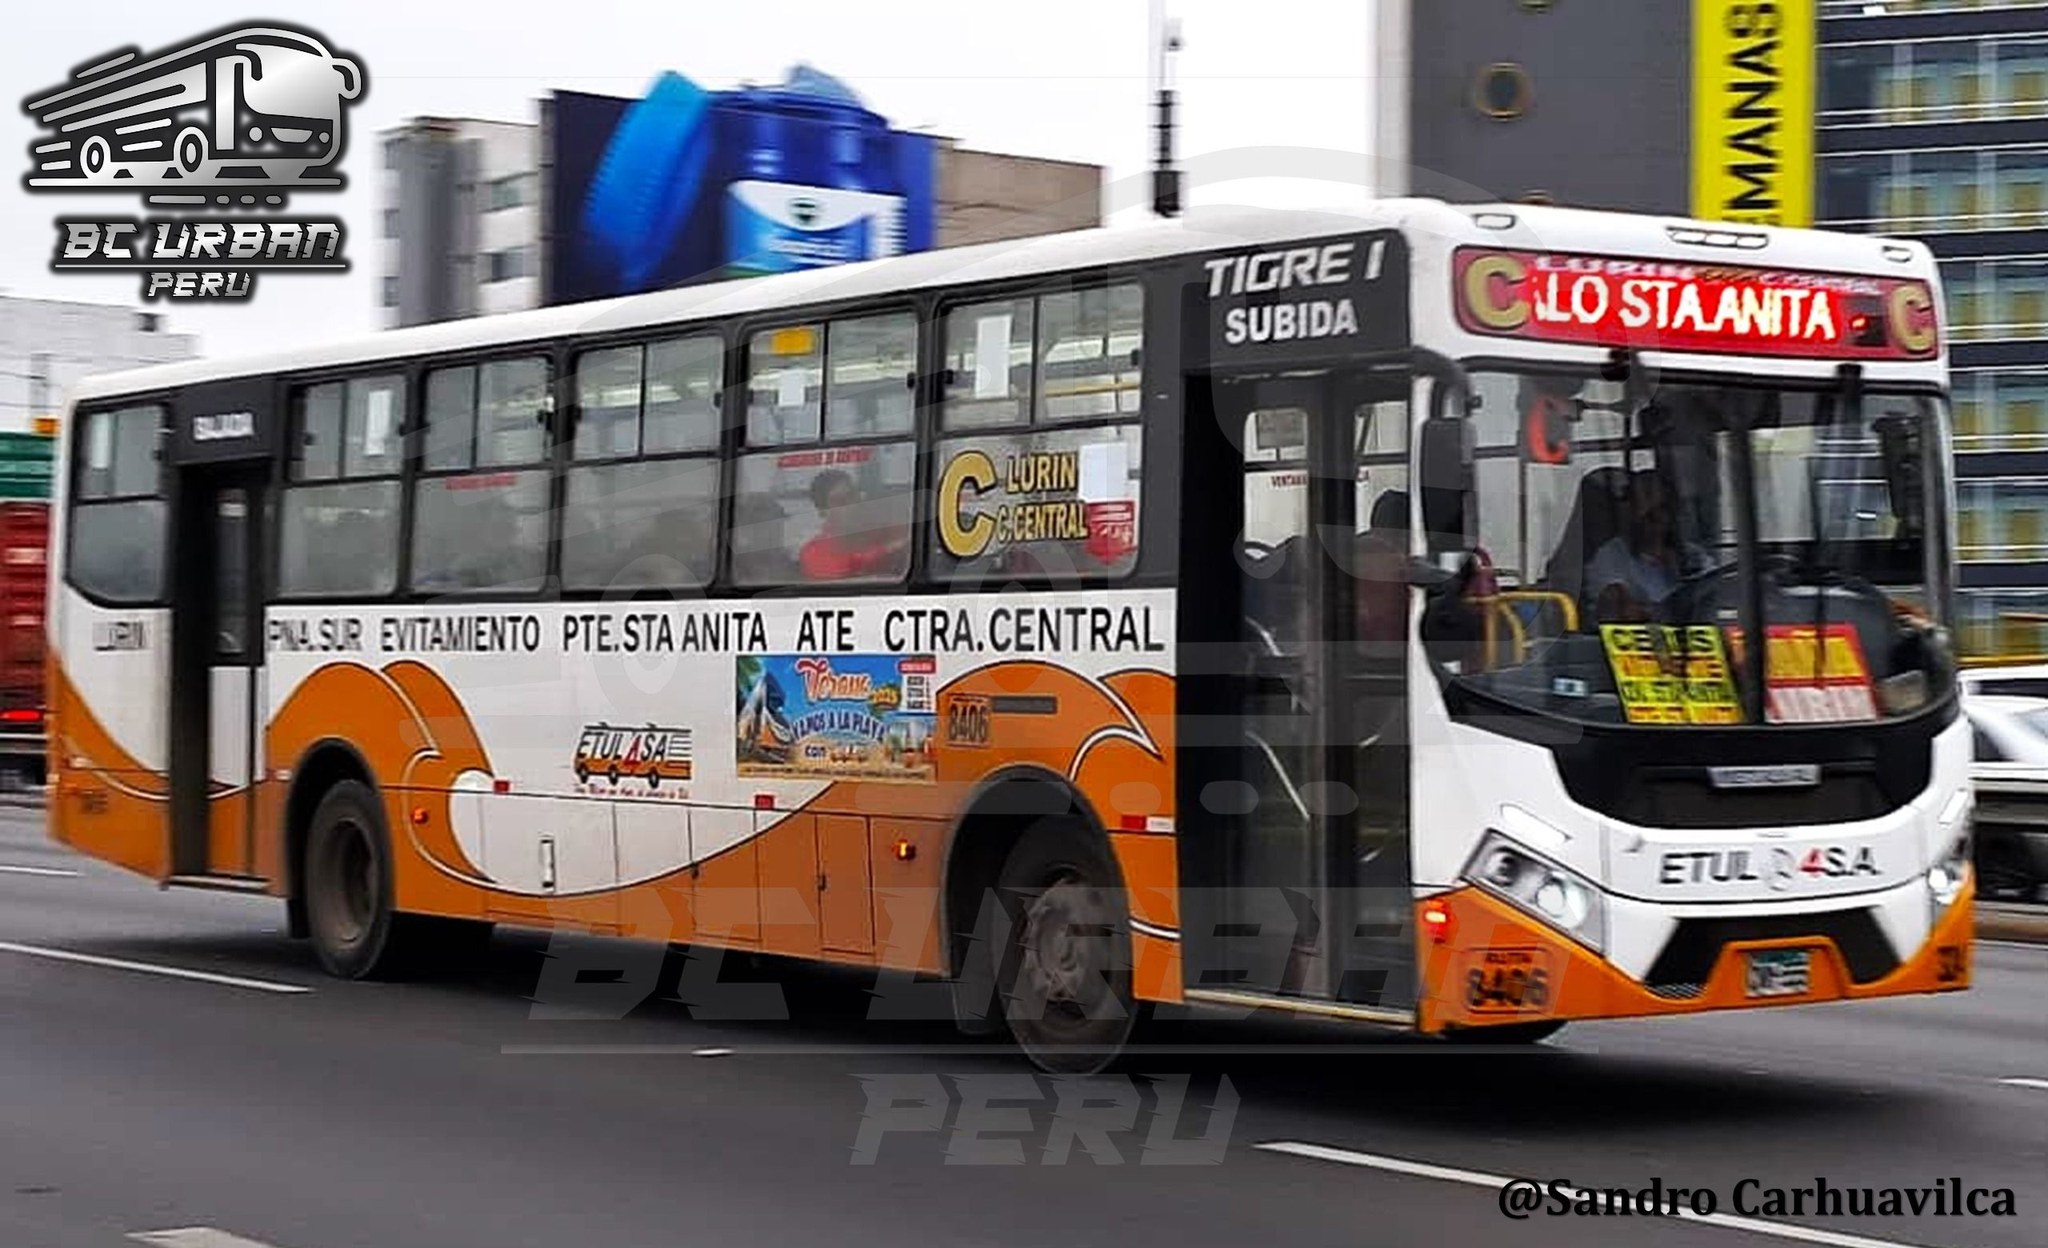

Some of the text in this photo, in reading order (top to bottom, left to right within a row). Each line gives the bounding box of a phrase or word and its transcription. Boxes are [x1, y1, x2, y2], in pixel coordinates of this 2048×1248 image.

[1204, 243, 1354, 297] TIGRE
[1225, 299, 1358, 344] SUBIDA
[1007, 453, 1077, 494] LURIN
[937, 451, 997, 558] C
[381, 614, 540, 651] EVITAMIENTO
[682, 612, 767, 652] ANITA
[797, 610, 855, 652] ATE
[949, 703, 989, 743] 8406
